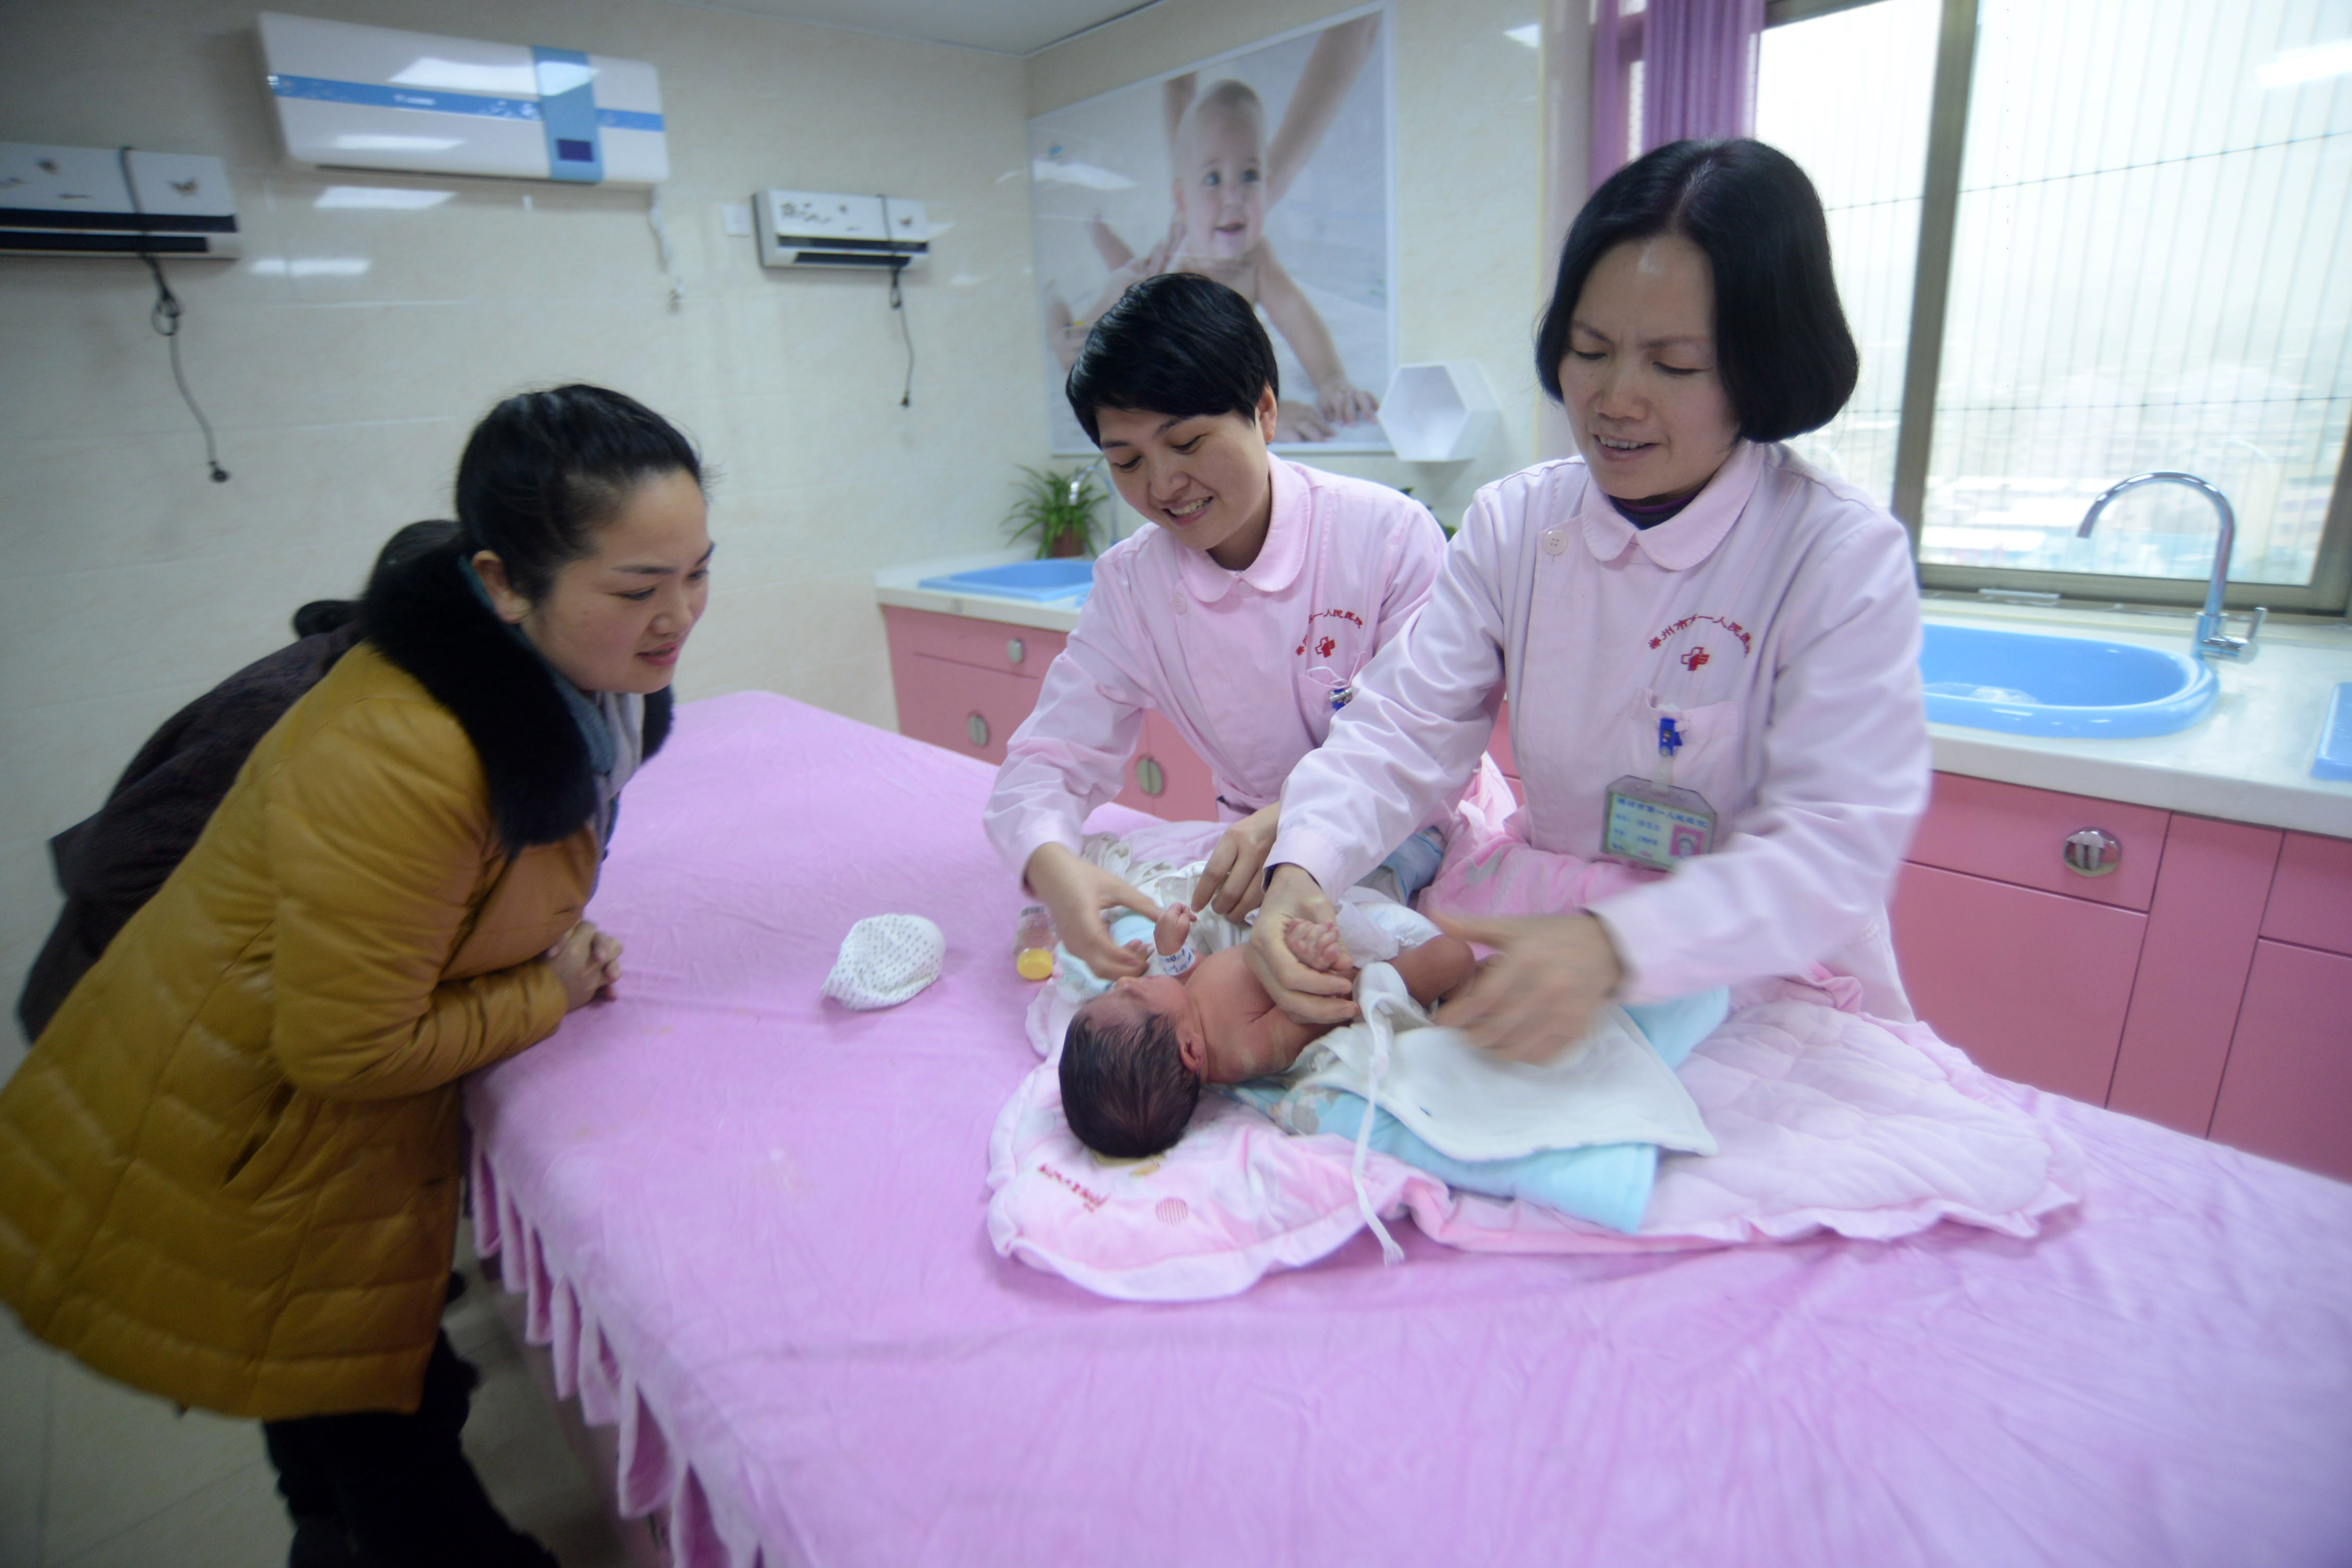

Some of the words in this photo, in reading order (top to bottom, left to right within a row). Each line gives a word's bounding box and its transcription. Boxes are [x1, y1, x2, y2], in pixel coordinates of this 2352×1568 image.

[1295, 608, 1363, 656] 一人民医院
